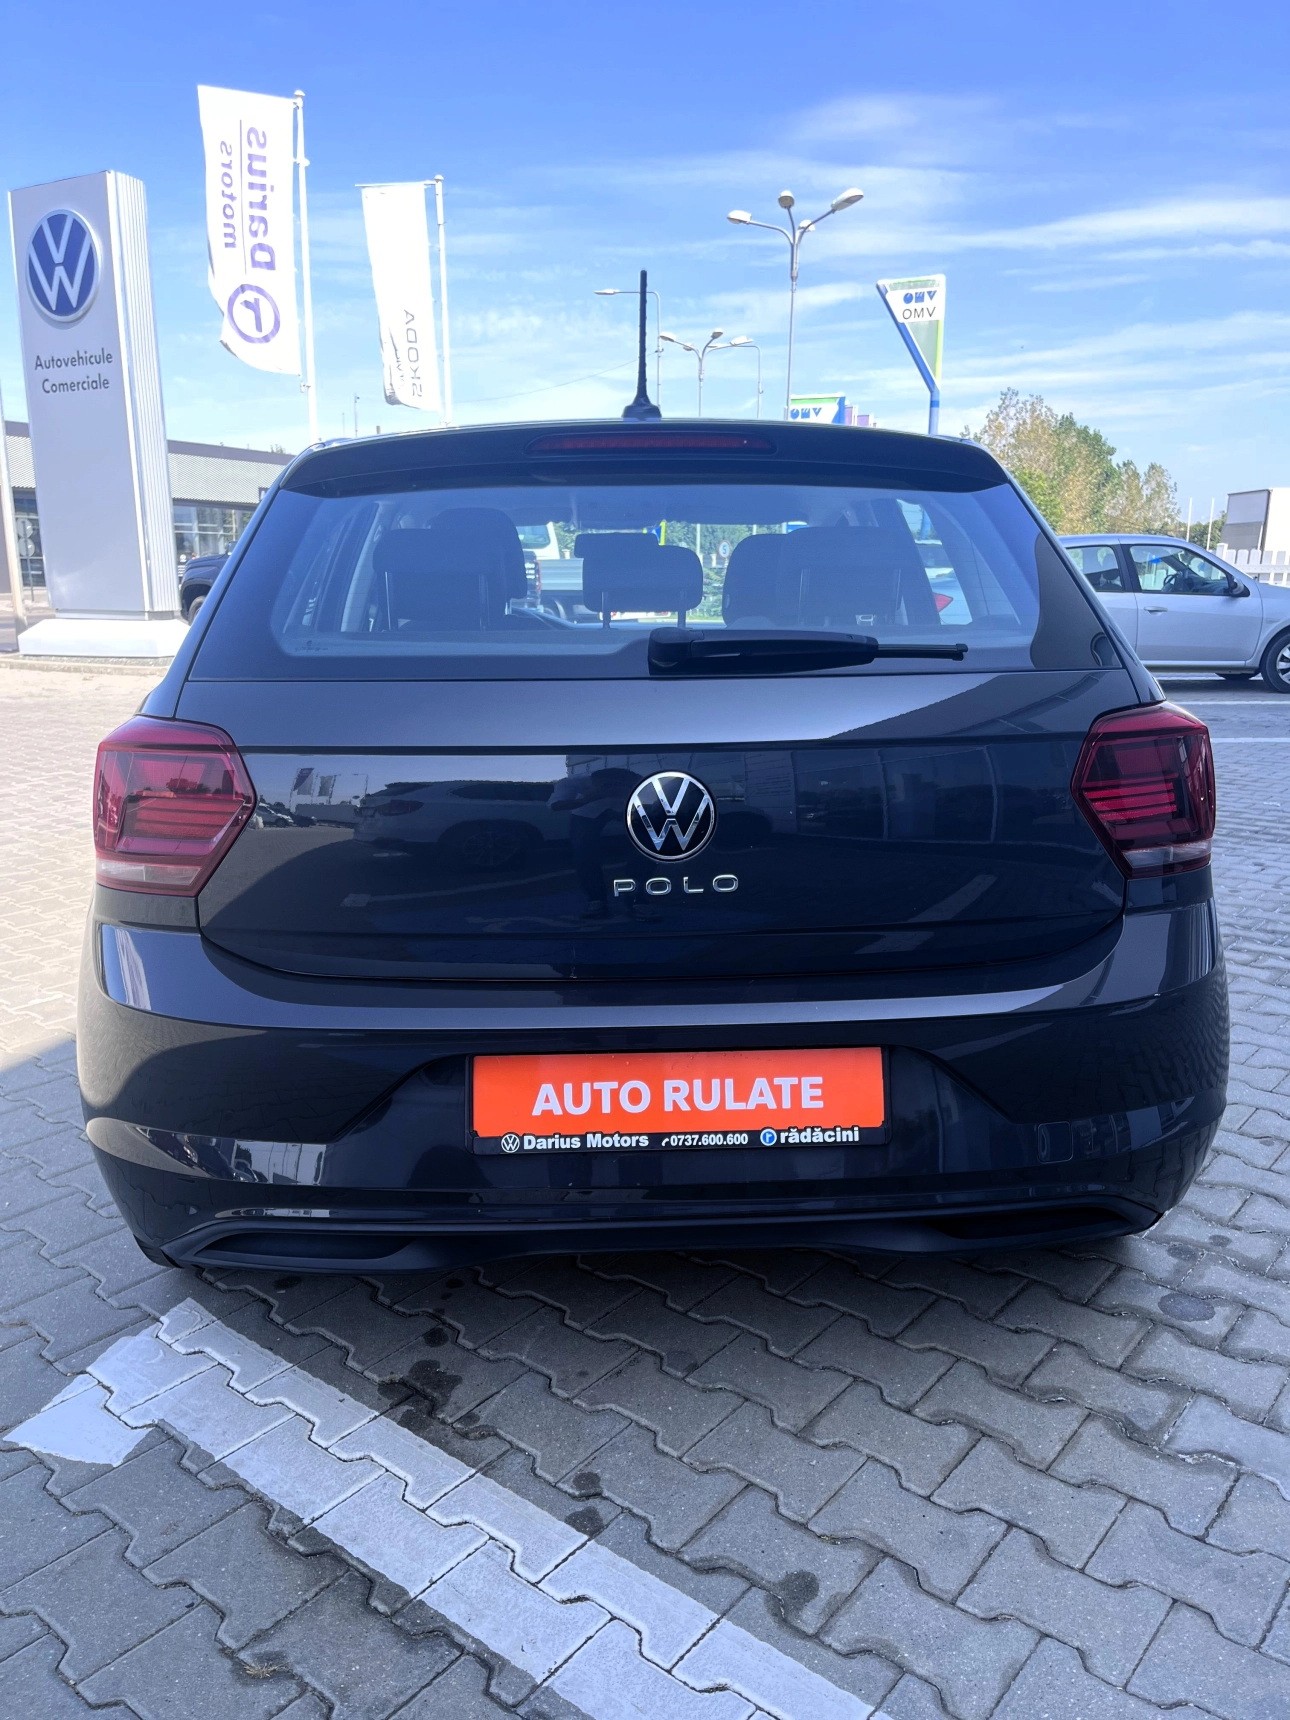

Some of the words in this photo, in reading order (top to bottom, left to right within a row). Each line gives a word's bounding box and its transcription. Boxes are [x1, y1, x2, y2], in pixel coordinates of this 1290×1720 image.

[902, 306, 936, 320] OMV
[34, 347, 114, 371] Autovehicule
[41, 373, 110, 394] Comerciale
[613, 874, 739, 897] POLO
[531, 1080, 651, 1116] AUTO
[663, 1076, 824, 1112] RULATE
[523, 1134, 581, 1150] Darius
[587, 1133, 650, 1148] Motors
[670, 1133, 748, 1146] 0737.600.600
[780, 1127, 860, 1144] rădăcini
